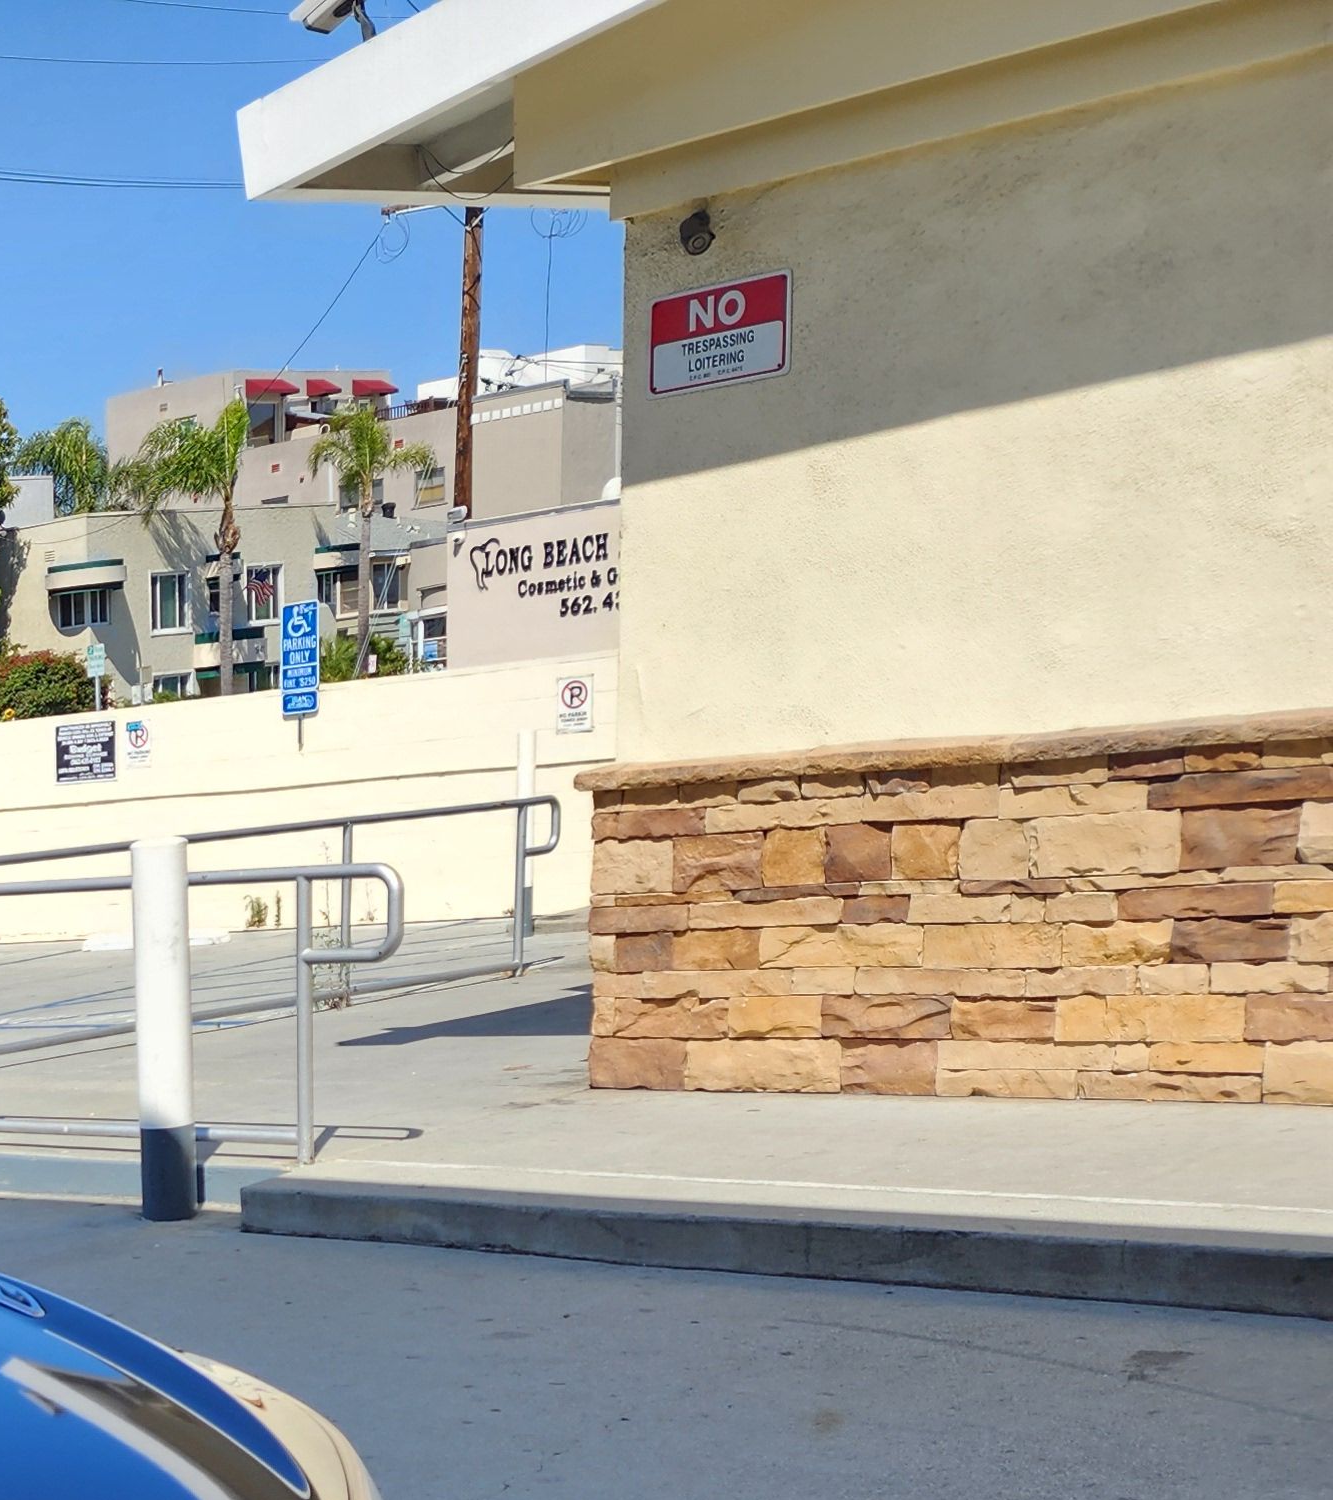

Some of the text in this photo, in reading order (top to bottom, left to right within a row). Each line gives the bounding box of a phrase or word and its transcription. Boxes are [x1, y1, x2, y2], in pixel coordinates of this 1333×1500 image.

[689, 289, 746, 332] NO
[681, 330, 755, 356] TRESPASSING
[688, 350, 745, 372] LOITERING
[482, 533, 609, 578] LONG BEACH
[518, 571, 586, 598] Cosmetic
[591, 569, 602, 588] &
[283, 635, 317, 652] PARKING
[289, 650, 311, 665] ONLY
